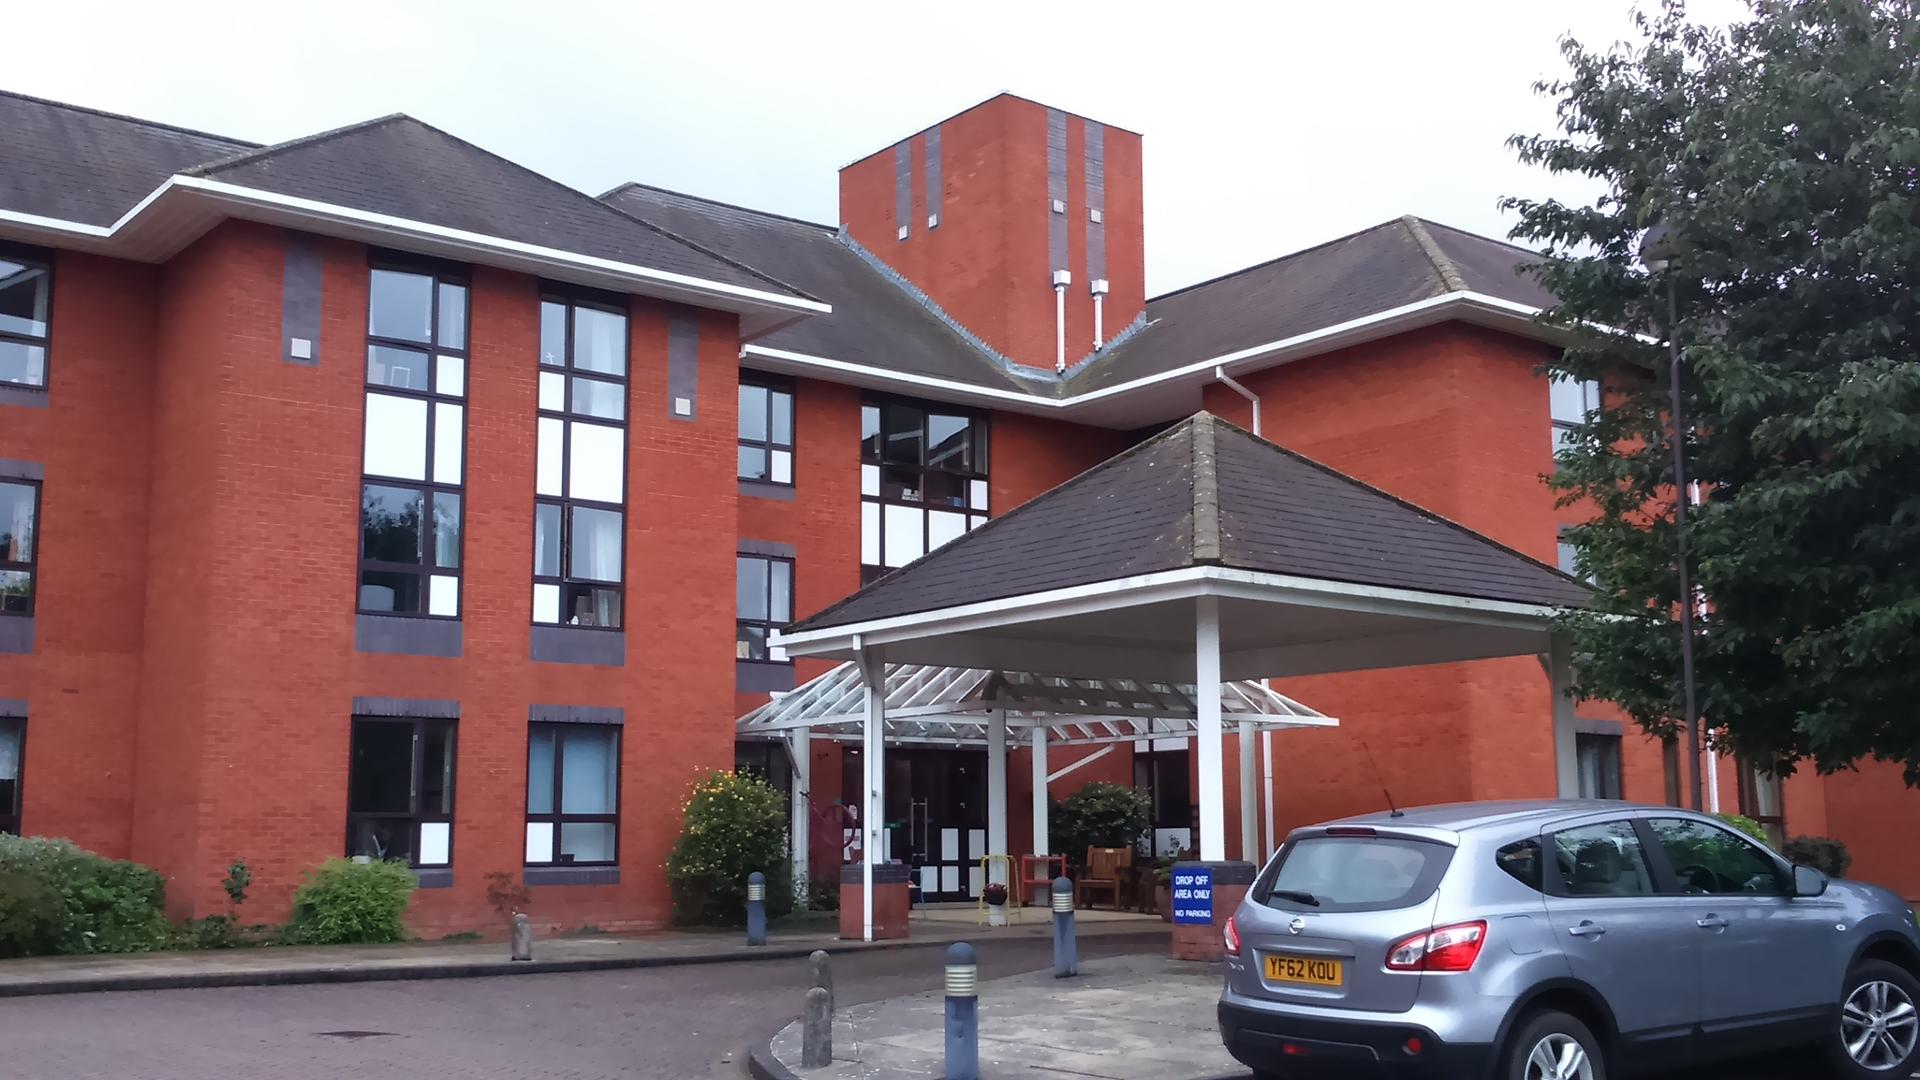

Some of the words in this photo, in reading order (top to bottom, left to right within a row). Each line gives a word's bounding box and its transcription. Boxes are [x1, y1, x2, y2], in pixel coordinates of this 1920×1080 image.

[1175, 875, 1194, 885] DROP
[1195, 875, 1209, 885] OFF
[1174, 889, 1192, 899] AREA
[1193, 889, 1210, 899] ONLY
[1185, 910, 1211, 918] PARKING
[1269, 957, 1305, 978] YF62
[1307, 960, 1336, 981] KOU
